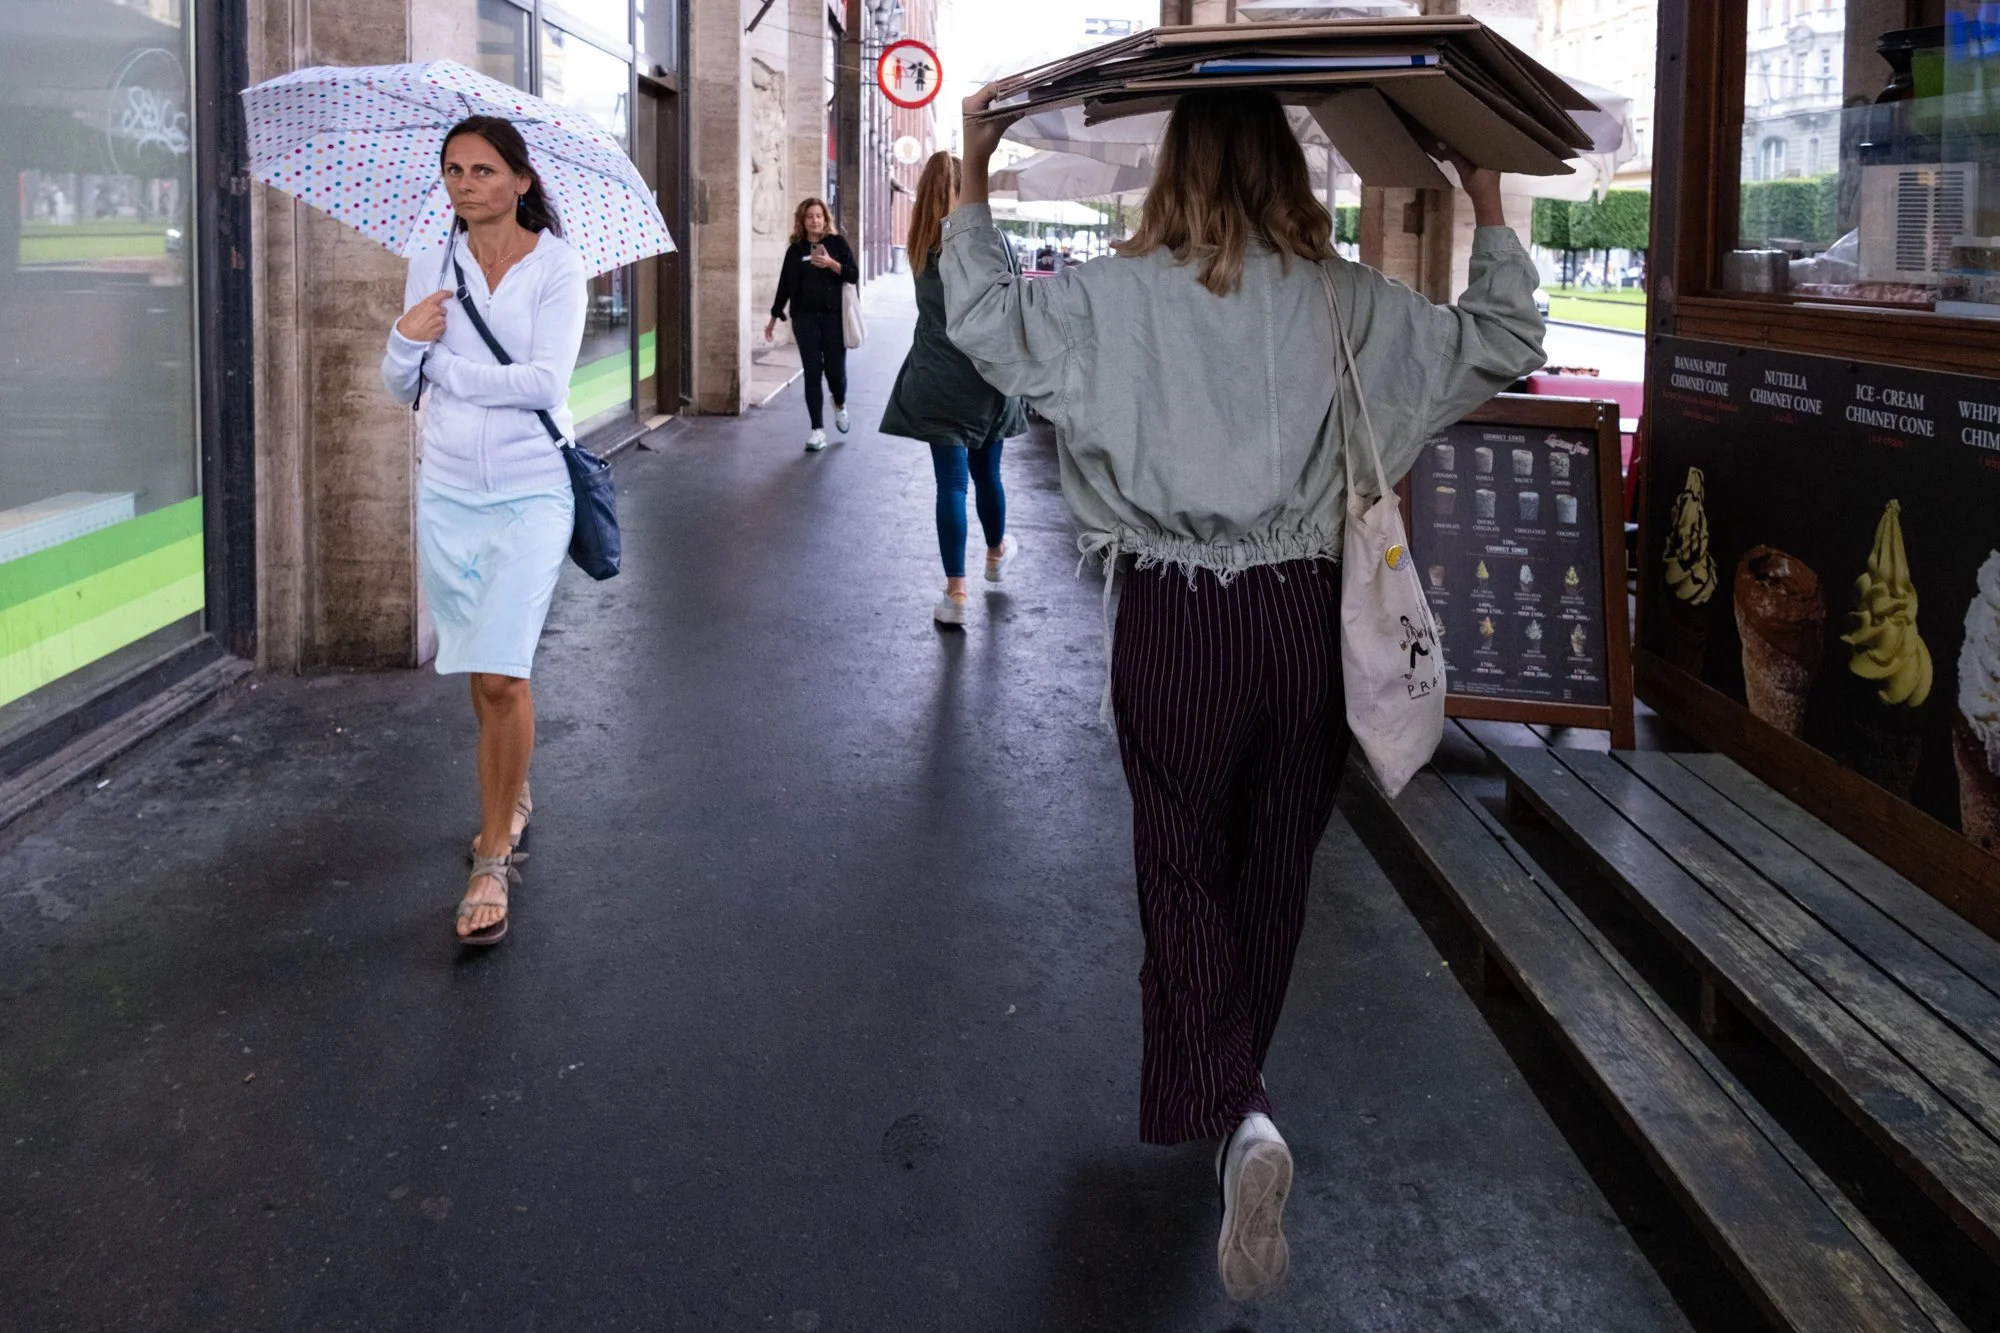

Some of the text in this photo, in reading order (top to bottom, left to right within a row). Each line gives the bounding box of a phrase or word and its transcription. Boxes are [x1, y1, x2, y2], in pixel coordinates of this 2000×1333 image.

[1674, 355, 1727, 376] BANANA SPLIT
[1670, 373, 1730, 397] CHIMNEY CONE
[1764, 369, 1808, 391] NUTELLA
[1750, 387, 1793, 410] CHIMNEY
[1793, 395, 1823, 415] CONE
[1882, 388, 1926, 411] CREAM
[1845, 404, 1936, 438] CHIMNEY CONE
